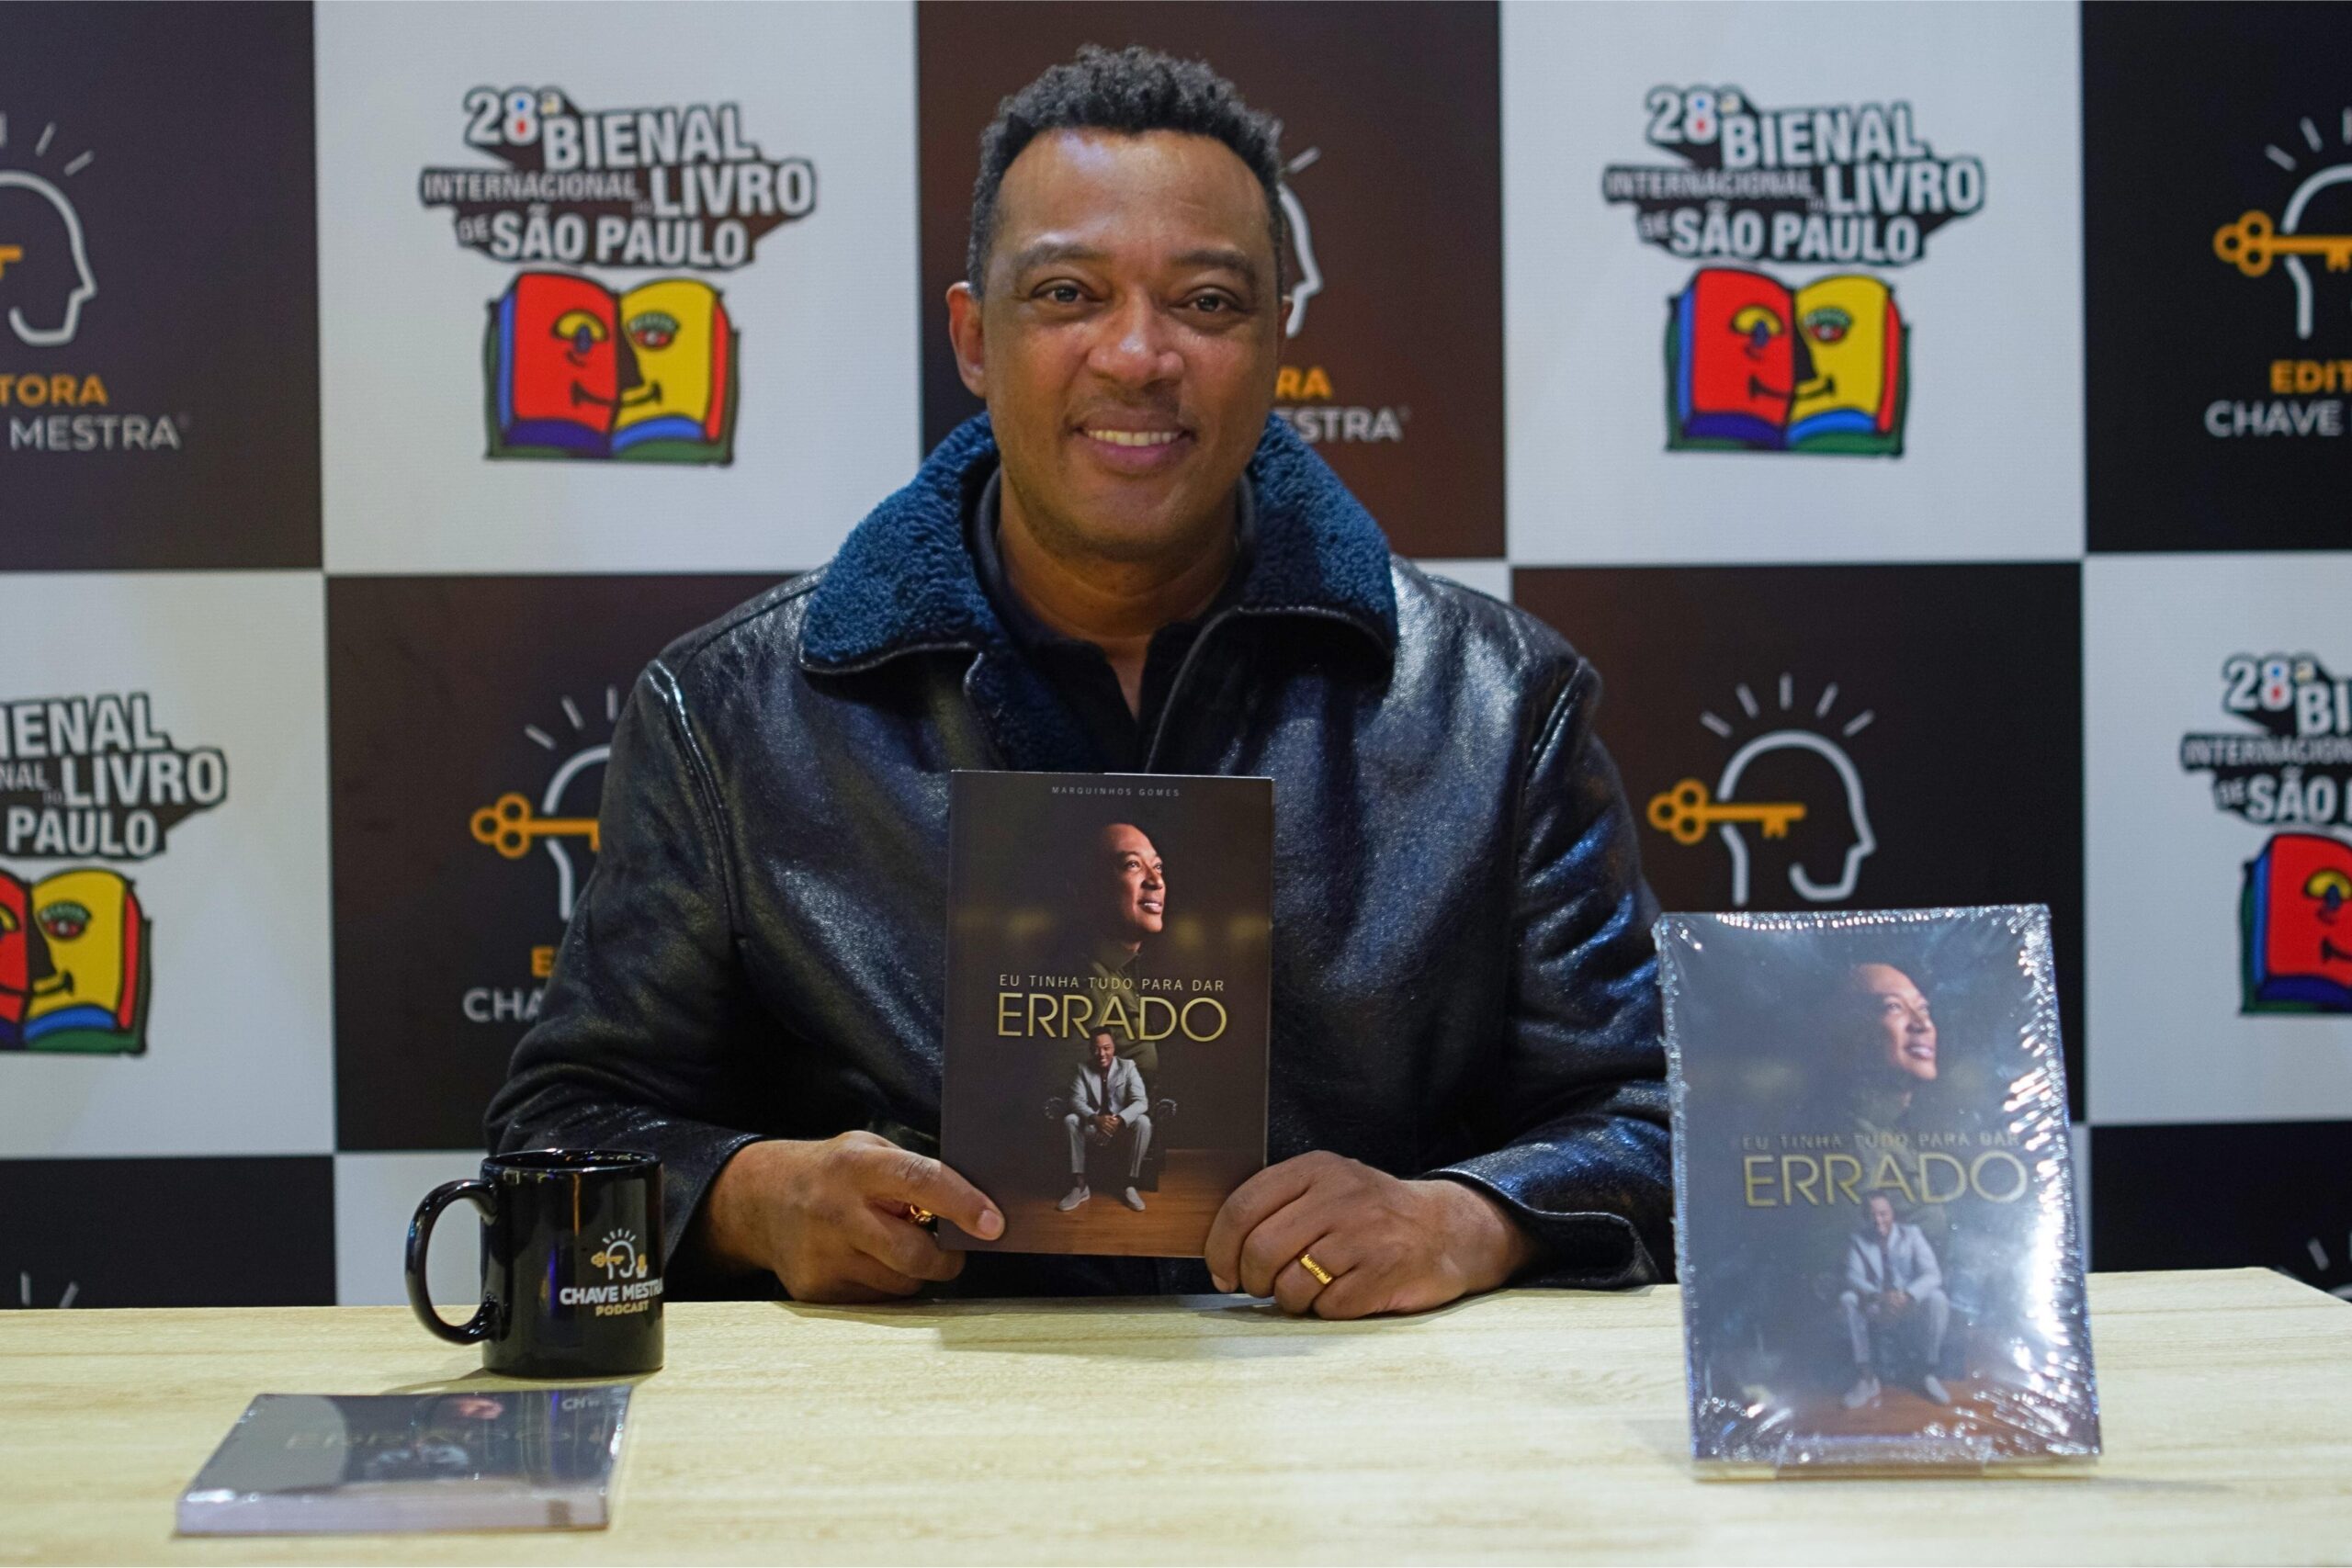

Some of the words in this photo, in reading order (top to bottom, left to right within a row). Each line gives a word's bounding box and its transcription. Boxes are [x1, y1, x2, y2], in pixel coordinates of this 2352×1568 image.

[542, 105, 755, 171] BIENAL
[1721, 104, 1927, 168] BIENAL
[423, 170, 640, 202] INTERNACIONAL
[650, 161, 815, 218] LIVRO
[1825, 159, 1984, 214] LIVRO
[490, 201, 587, 262] SÃO
[595, 216, 748, 265] PAULO
[1670, 199, 1765, 256] SÃO
[1772, 212, 1921, 261] PAULO
[9, 413, 182, 452] MESTRA
[2204, 399, 2344, 438] CHAVE
[61, 750, 226, 807] LIVRO
[1051, 785, 1132, 796] MARQUINHOS
[1138, 787, 1181, 797] GOMES
[2245, 765, 2338, 823] SÃO
[6, 805, 157, 856] PAULO
[999, 974, 1020, 987] EU
[1028, 975, 1080, 988] TINHA
[1088, 976, 1134, 990] TUDO
[1141, 978, 1183, 991] PARA
[1192, 979, 1225, 992] DAR
[998, 992, 1227, 1043] ERRADO
[1918, 1131, 1970, 1147] PARA
[1743, 1149, 2029, 1208] ERRADO
[559, 1286, 619, 1305] CHAVE
[594, 1300, 650, 1317] PODCAST
